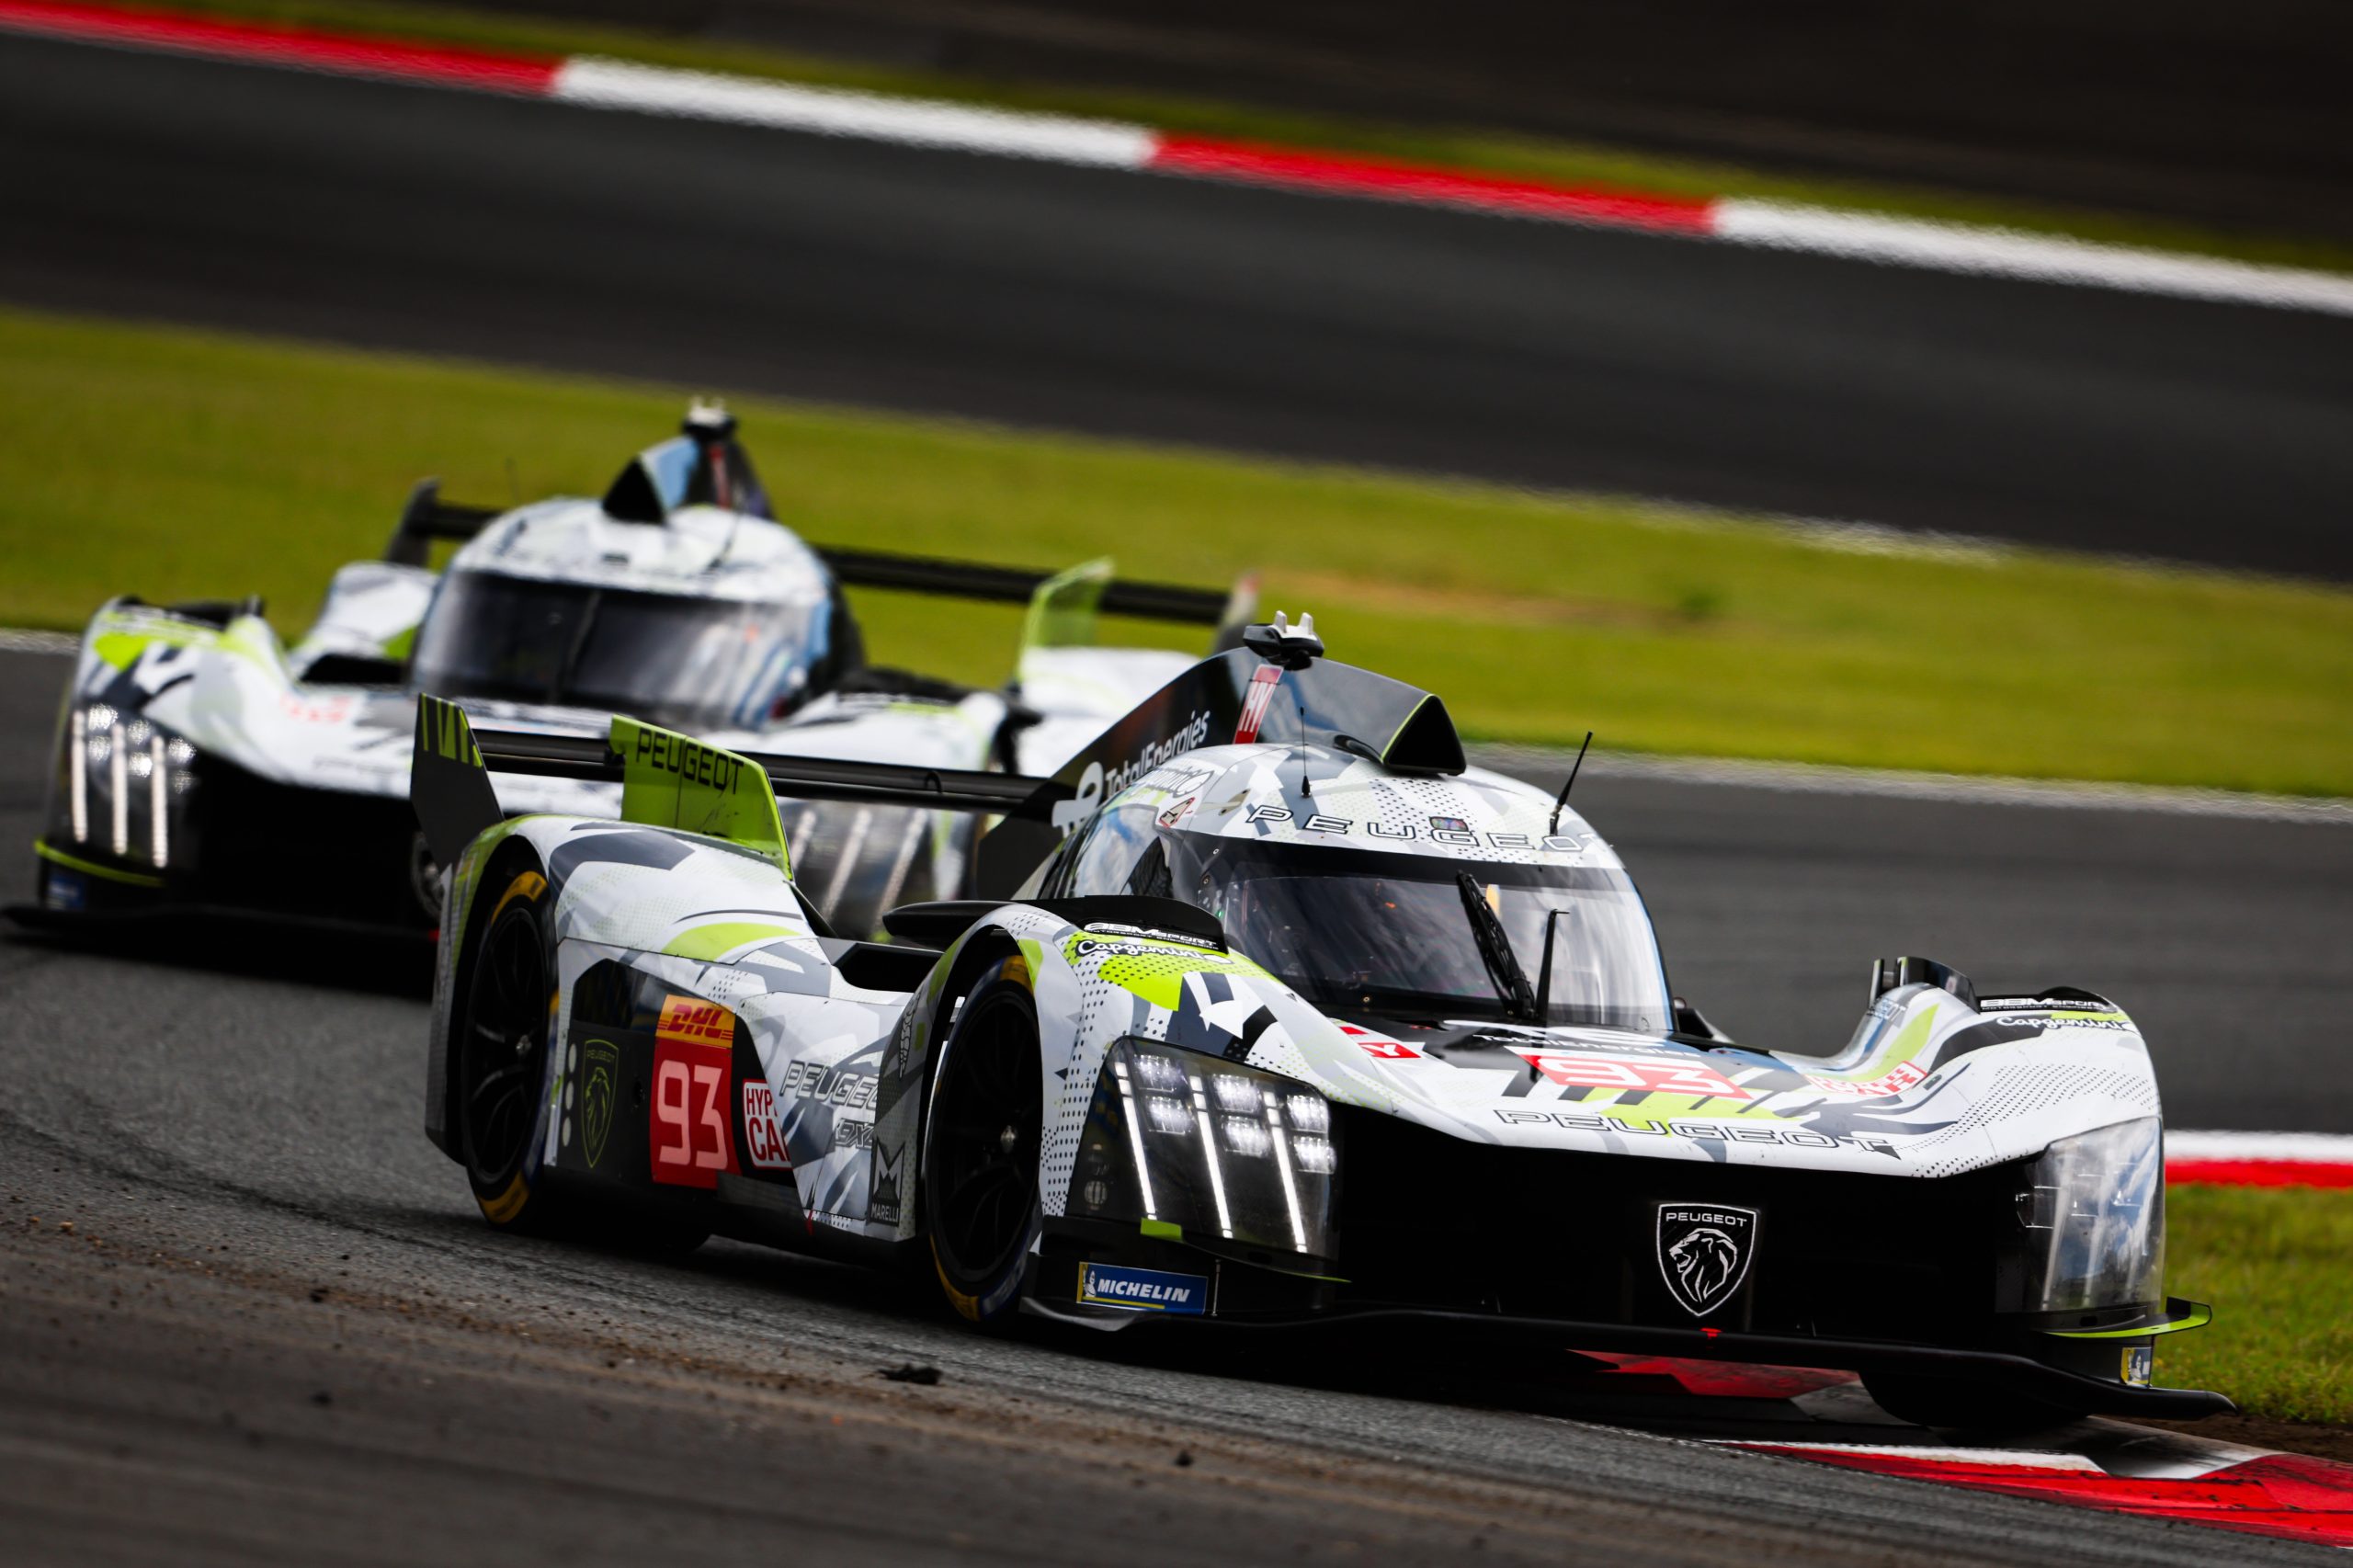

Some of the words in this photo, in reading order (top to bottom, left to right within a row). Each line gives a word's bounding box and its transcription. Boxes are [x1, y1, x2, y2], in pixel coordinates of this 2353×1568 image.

[635, 726, 745, 795] PEUGEOT
[1245, 804, 1605, 853] PEUGEOT
[1077, 939, 1206, 960] Capgemini
[666, 1003, 723, 1039] DHL
[1995, 1016, 2123, 1031] Capgemini
[1472, 1034, 1701, 1058] TotalEnergies
[1536, 1056, 1740, 1095] 93
[657, 1059, 729, 1171] 93
[745, 1087, 779, 1118] HYP
[1493, 1108, 1899, 1151] PEUGEOT
[870, 1202, 900, 1223] MARELLI
[1665, 1212, 1747, 1227] PEUGEOT
[1097, 1278, 1191, 1303] MICHELIN
